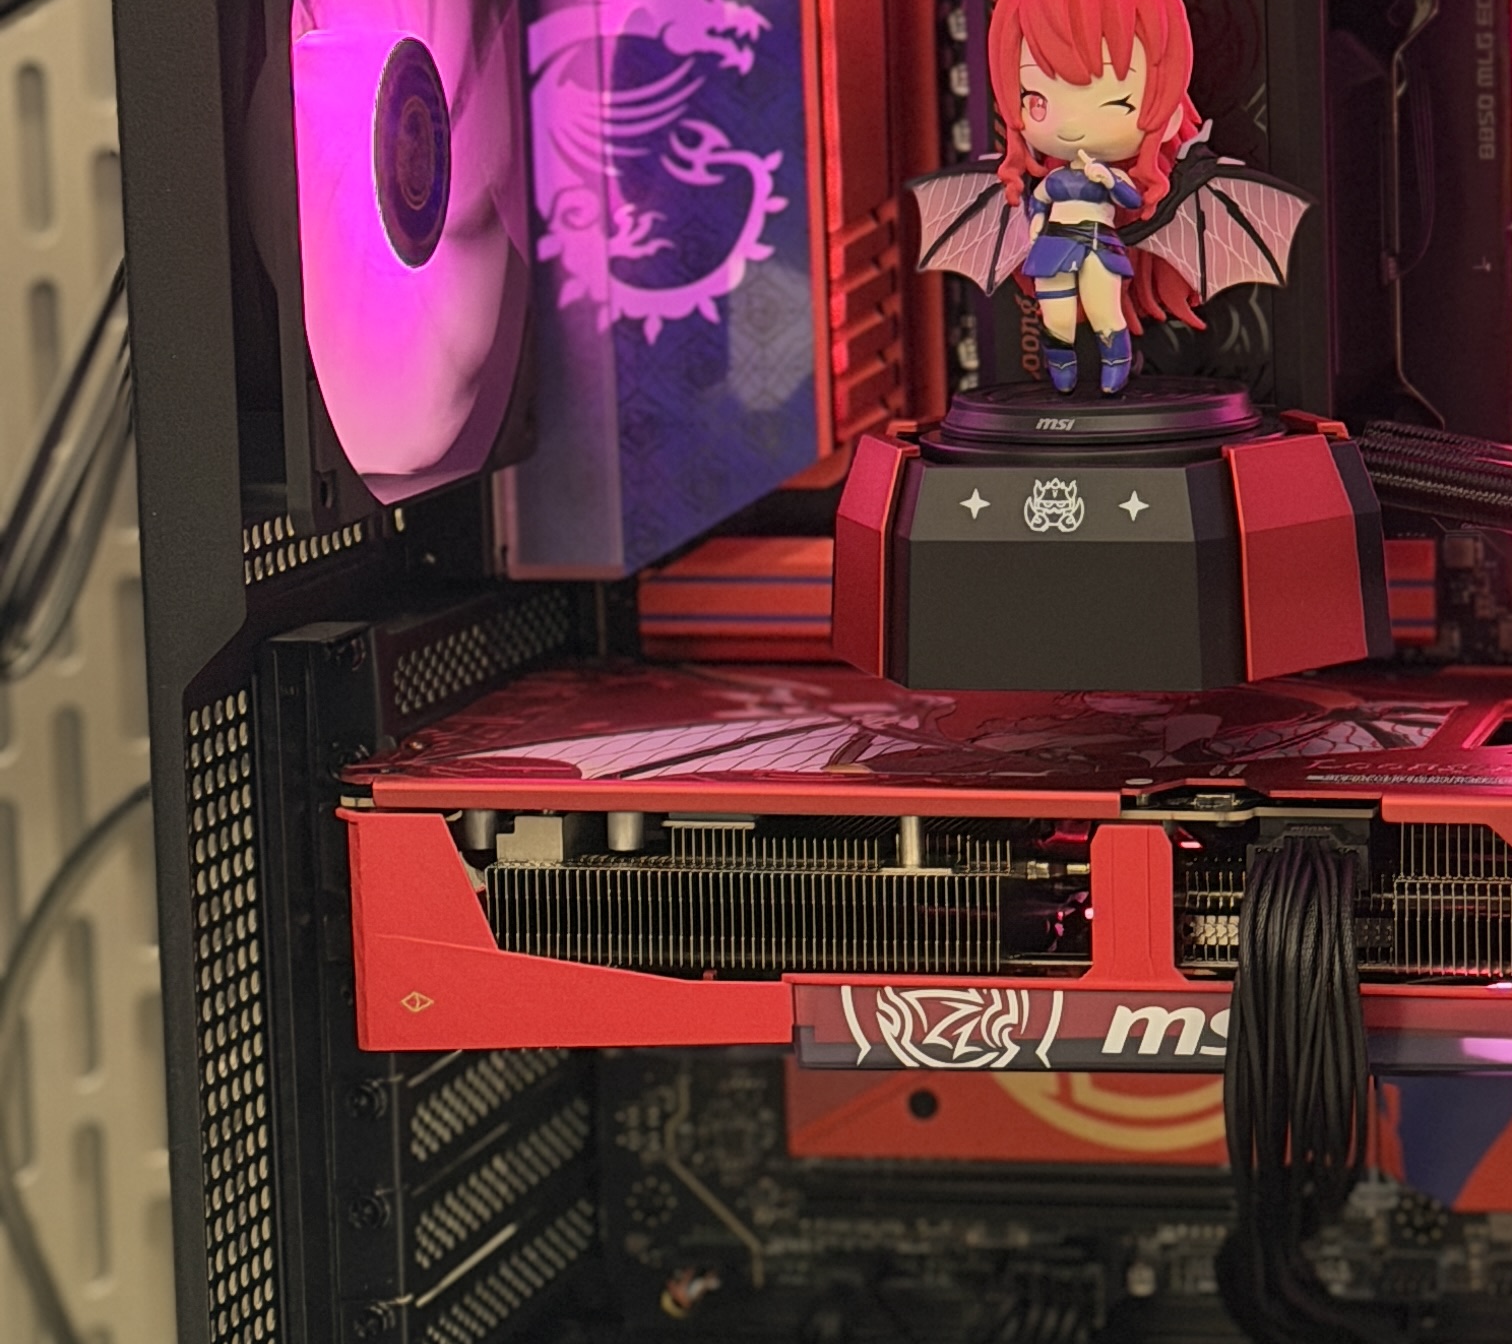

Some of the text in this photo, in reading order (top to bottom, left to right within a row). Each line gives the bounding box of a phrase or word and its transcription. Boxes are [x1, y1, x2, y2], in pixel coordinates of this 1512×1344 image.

[1476, 33, 1494, 87] MLG
[1014, 293, 1041, 380] oong
[1036, 417, 1076, 431] msi
[1101, 1005, 1231, 1056] ms
